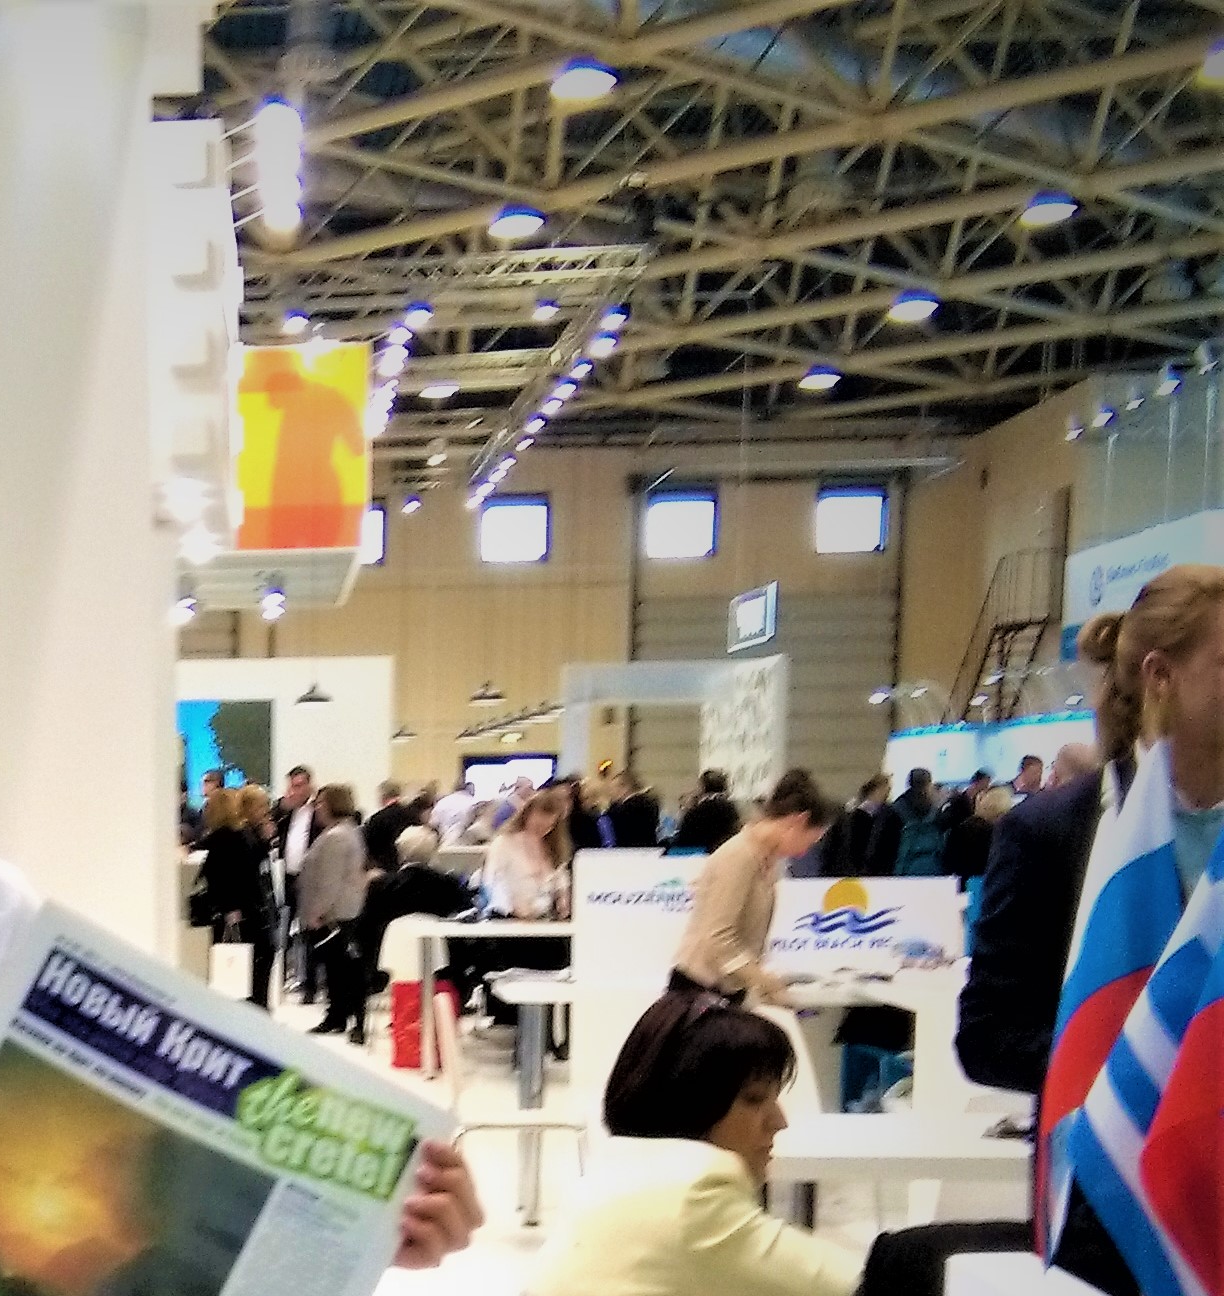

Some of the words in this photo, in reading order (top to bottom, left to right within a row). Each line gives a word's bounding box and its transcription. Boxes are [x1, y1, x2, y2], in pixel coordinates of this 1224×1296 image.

[38, 954, 160, 1047] Новый
[155, 1020, 255, 1090] Крит
[239, 1067, 320, 1131] the
[316, 1092, 416, 1153] new
